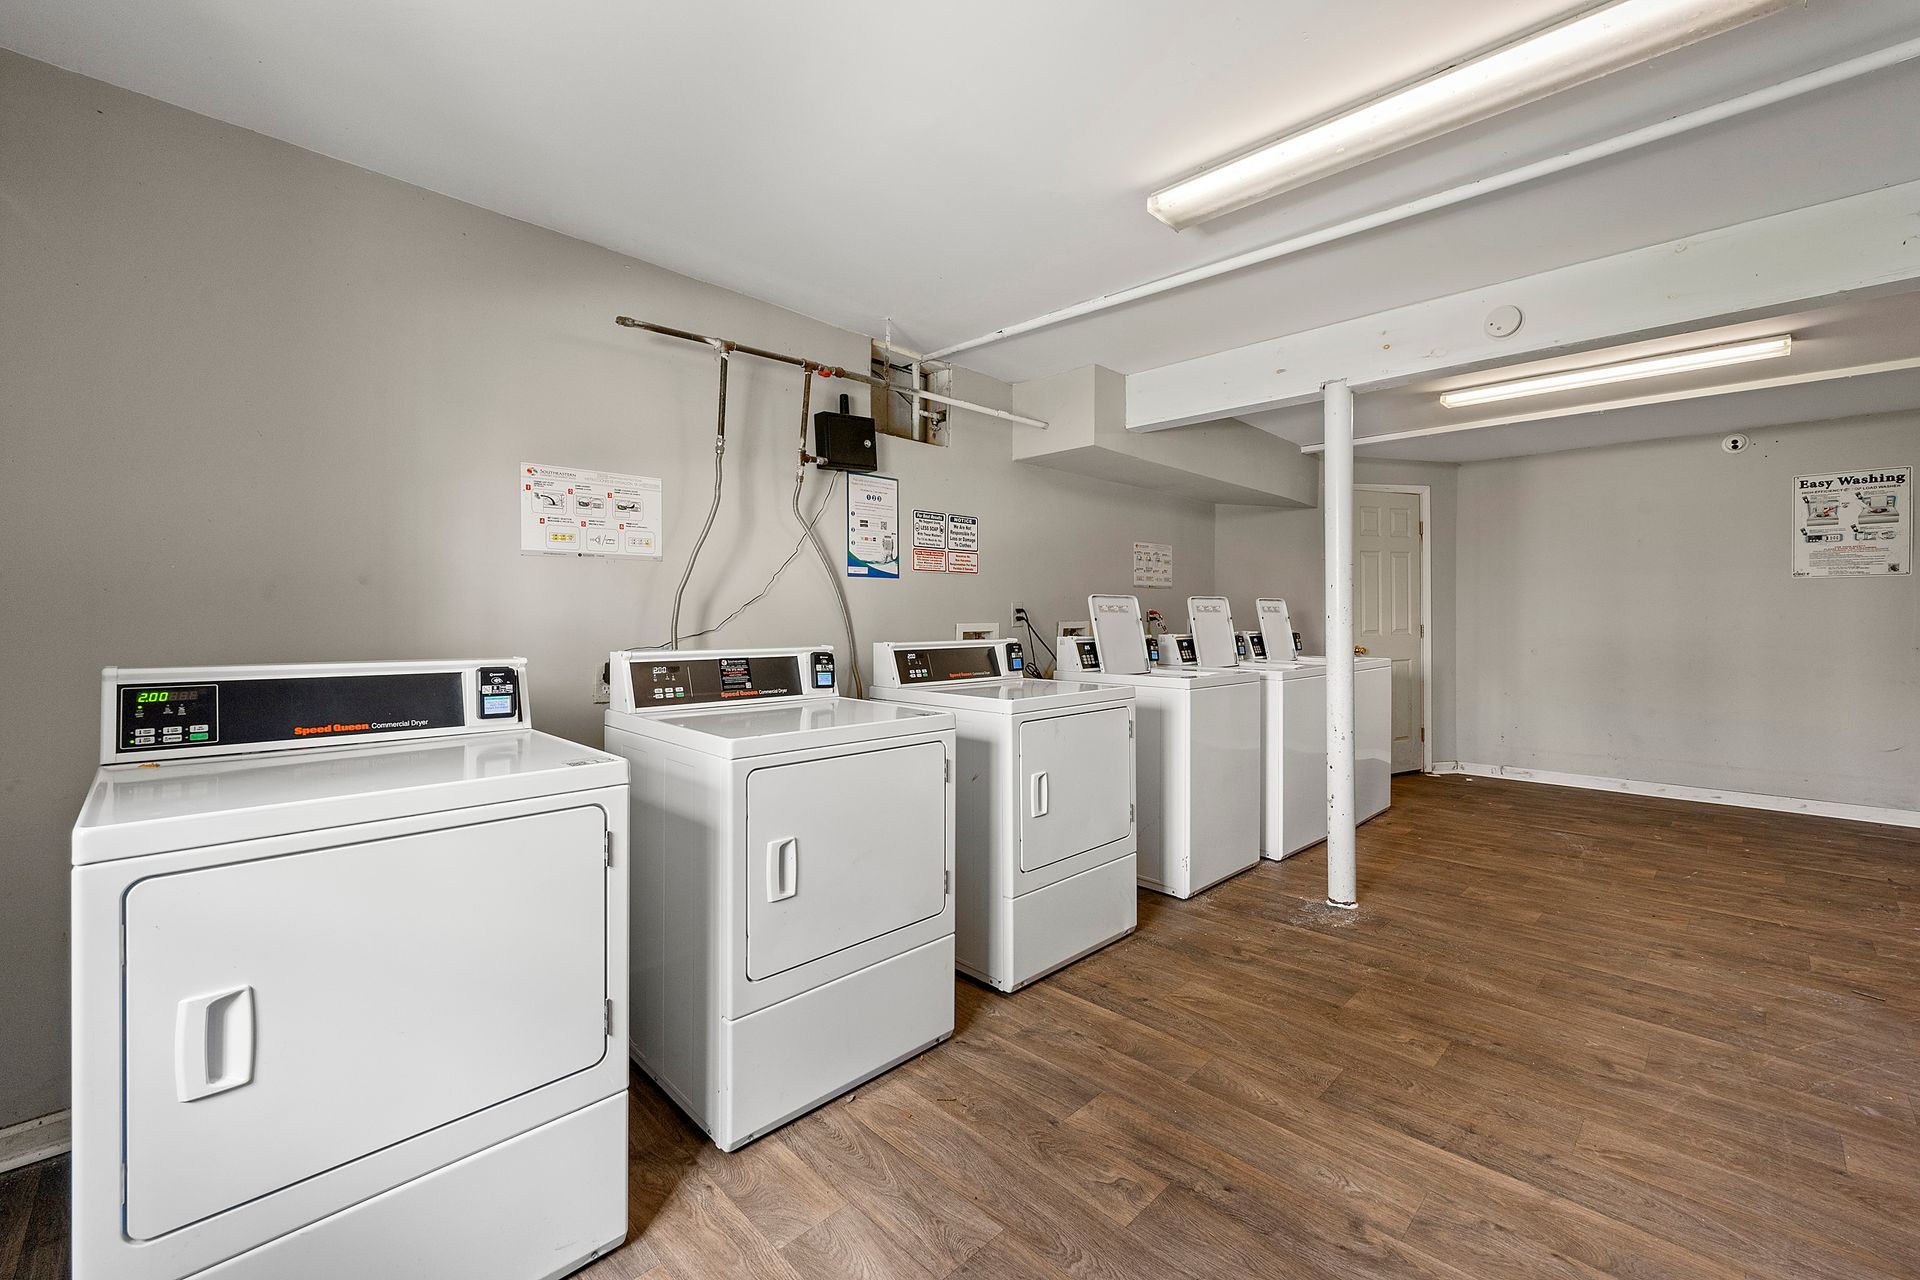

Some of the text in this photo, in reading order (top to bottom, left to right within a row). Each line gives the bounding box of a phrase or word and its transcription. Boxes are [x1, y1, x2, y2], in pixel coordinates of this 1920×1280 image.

[540, 469, 576, 477] SOUTHEASTERN
[1800, 474, 1906, 489] Easy Washing
[137, 692, 168, 703] 2.00
[294, 724, 332, 735] Speed
[334, 723, 368, 732] Queen
[372, 720, 410, 729] Commercial
